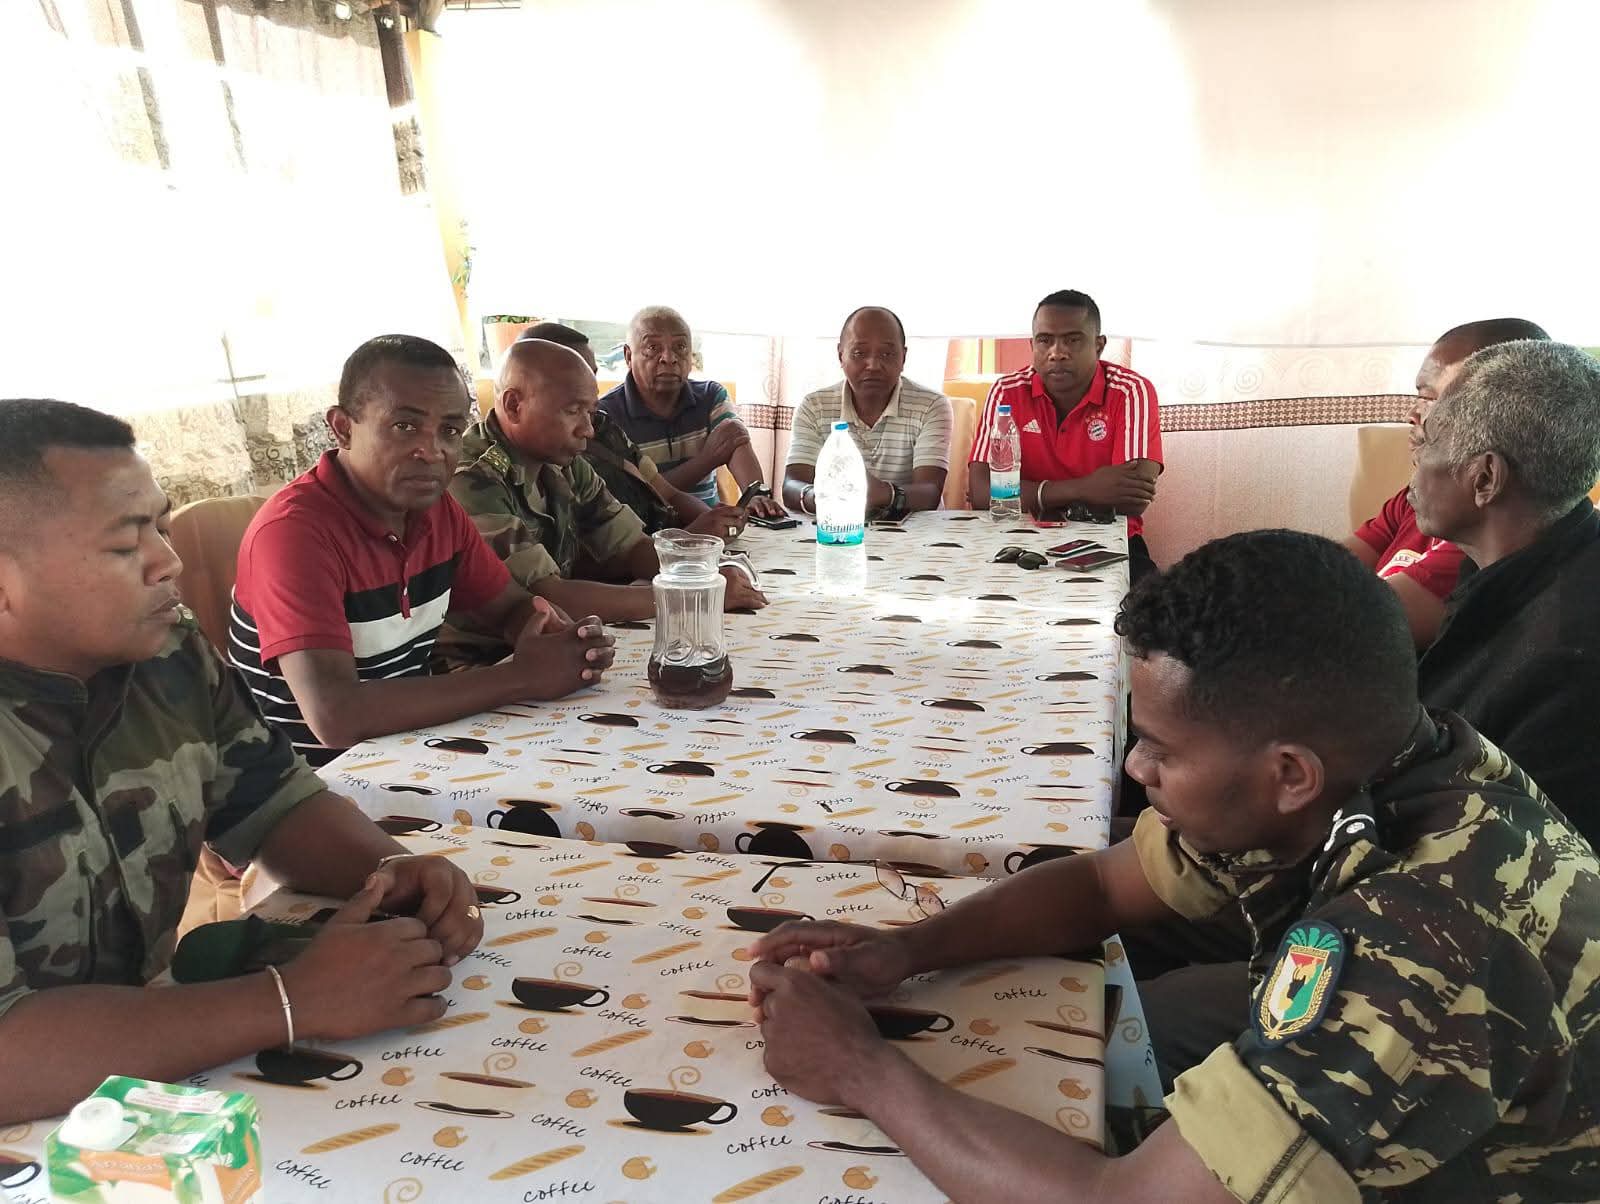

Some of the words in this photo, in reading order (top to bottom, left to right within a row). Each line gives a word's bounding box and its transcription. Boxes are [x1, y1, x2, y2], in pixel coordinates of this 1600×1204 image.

[540, 854, 584, 862] coffee
[696, 855, 735, 868] coffee
[618, 875, 662, 883] coffee
[817, 872, 860, 882] coffee
[535, 883, 584, 892] coffee
[691, 893, 733, 907] coffee
[506, 909, 558, 920] coffee
[826, 904, 873, 915] coffee
[659, 922, 701, 937] coffee
[563, 946, 612, 958] coffee
[661, 960, 714, 976] coffee
[994, 988, 1046, 1000] coffee
[598, 1008, 646, 1027] coffee
[491, 1038, 551, 1051] coffee
[950, 1035, 1005, 1055] coffee
[381, 1047, 444, 1060] coffee
[580, 1067, 632, 1087] coffee
[335, 1094, 402, 1109] coffee
[531, 1114, 586, 1137] coffee
[727, 1135, 792, 1154] coffee
[400, 1152, 464, 1171] coffee
[276, 1160, 331, 1188] coffee
[524, 1181, 595, 1202] coffee
